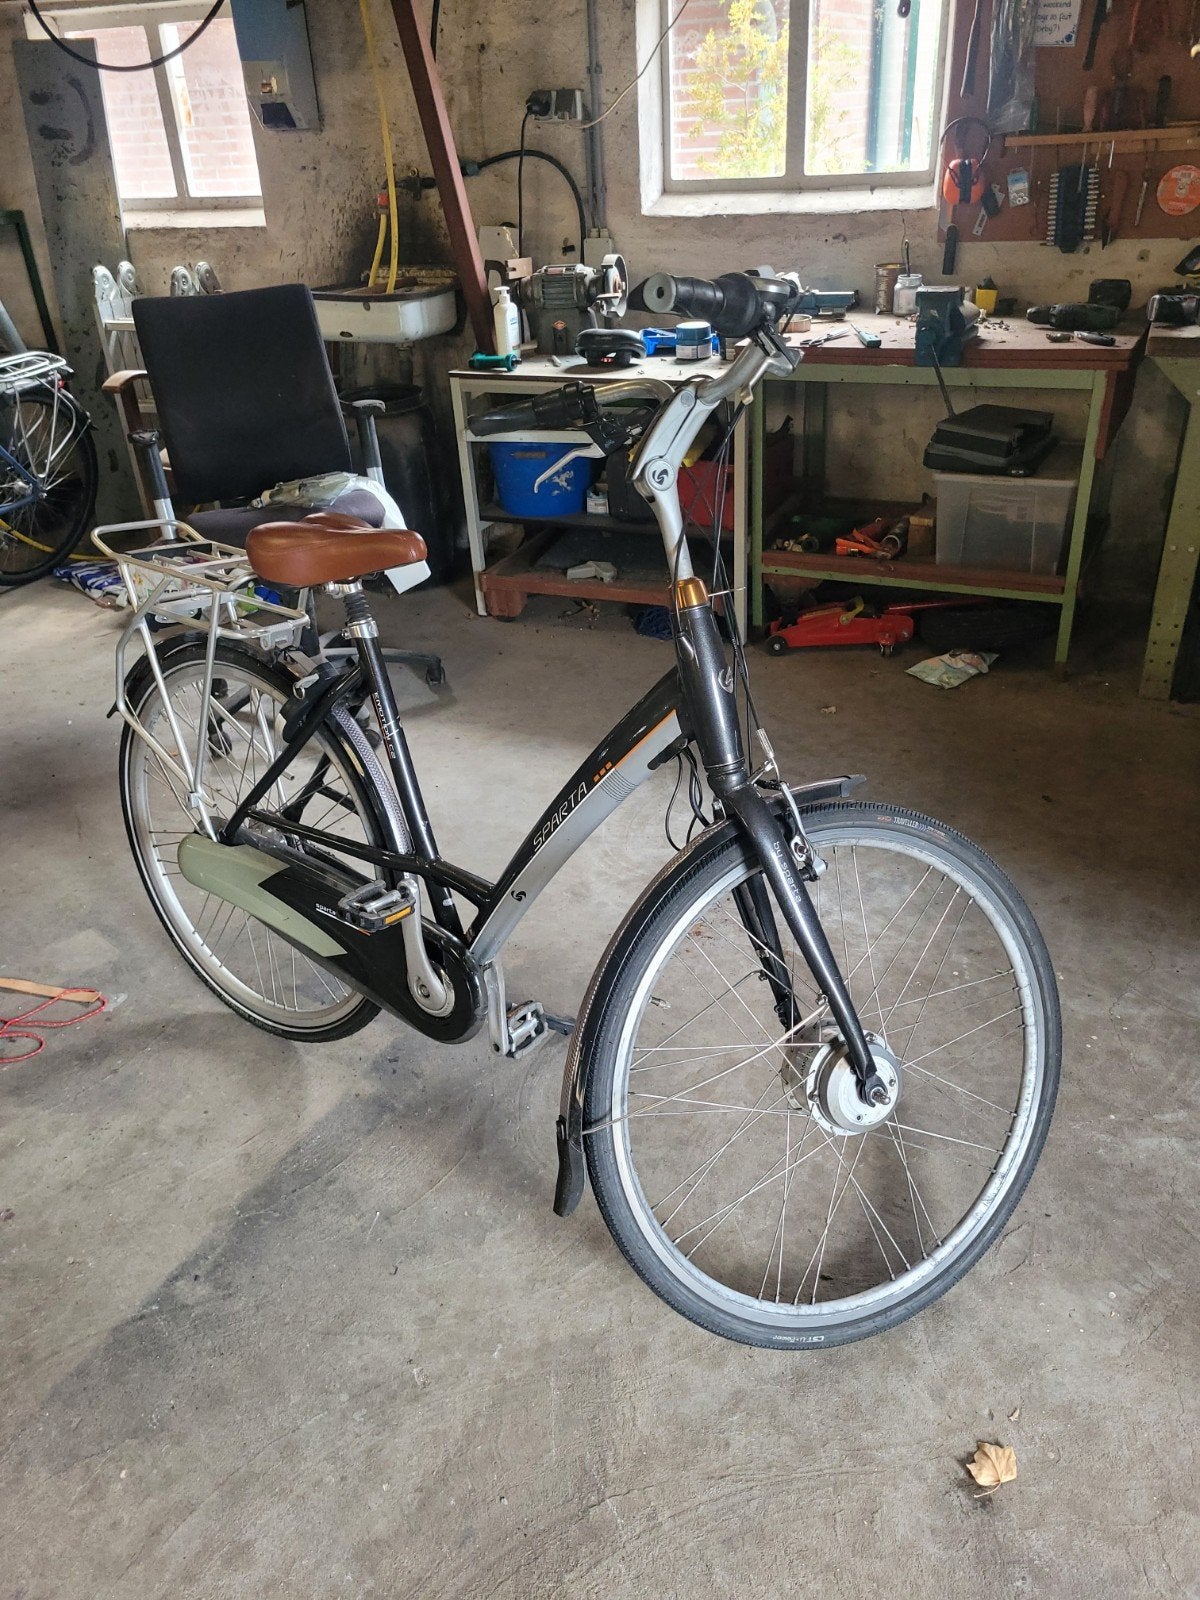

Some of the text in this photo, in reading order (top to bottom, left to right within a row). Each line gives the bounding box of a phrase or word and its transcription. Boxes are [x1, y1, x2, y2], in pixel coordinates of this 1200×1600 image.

[1059, 12, 1072, 22] fast
[533, 781, 588, 852] SPARTA
[773, 841, 802, 902] by sparta
[806, 1335, 825, 1343] CST
